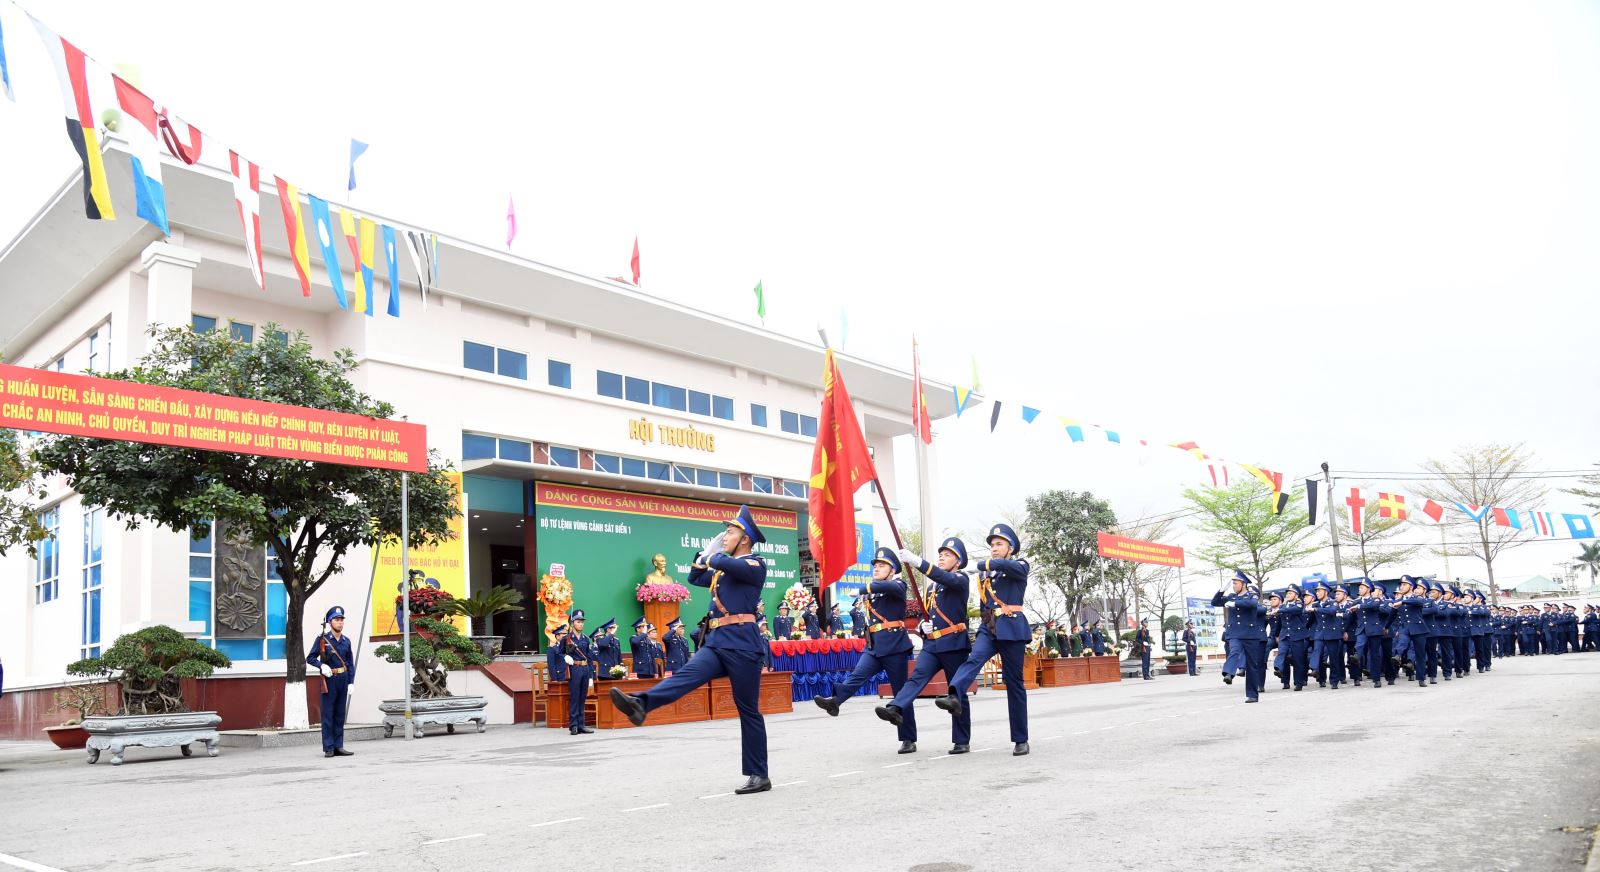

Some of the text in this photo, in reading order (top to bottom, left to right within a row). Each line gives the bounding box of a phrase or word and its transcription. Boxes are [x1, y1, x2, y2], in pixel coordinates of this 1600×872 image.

[8, 378, 38, 398] HUẤN
[42, 385, 79, 404] LUYỆN,
[82, 386, 104, 406] SẴN
[108, 392, 134, 410] SÀNG
[138, 396, 168, 414] CHIẾN
[170, 399, 192, 418] ĐẤU,
[194, 404, 212, 419] XÂY
[214, 408, 239, 424] DỰNG
[262, 412, 279, 429] NẾP
[281, 417, 306, 432] CHÍNH
[308, 421, 324, 436] QUY,
[344, 426, 368, 442] LUYỆN
[382, 428, 400, 446] LUẬT,
[2, 400, 34, 420] CHẮC
[36, 408, 52, 423] AN
[56, 412, 86, 428] NINH,
[88, 412, 110, 428] CHỦ
[151, 422, 170, 436] DUY
[172, 422, 188, 438] TRÌ
[190, 426, 226, 442] NGHIÊM
[228, 430, 252, 446] PHÁP
[254, 433, 275, 450] LUẬT
[277, 436, 298, 450] TRÊN
[300, 438, 322, 454] VÙNG
[324, 438, 342, 456] BIỂN
[344, 444, 364, 460] ĐƯỢC
[366, 446, 387, 462] PHÂN
[388, 448, 408, 464] CÔNG
[629, 416, 715, 452] HỘI TRƯỜNG
[545, 489, 578, 502] ĐẢNG
[581, 494, 612, 506] CỘNG
[616, 497, 636, 508] SẢN
[638, 499, 660, 512] VIỆT
[662, 504, 684, 514] NAM
[688, 506, 720, 517] QUANG
[752, 512, 770, 522] UÔN
[540, 517, 549, 530] BỘ
[550, 518, 558, 528] TƯ
[573, 520, 588, 532] VÙNG
[589, 520, 604, 532] CẢNH
[604, 522, 614, 533] SÁT
[628, 526, 632, 534] 1
[691, 537, 700, 548] RA
